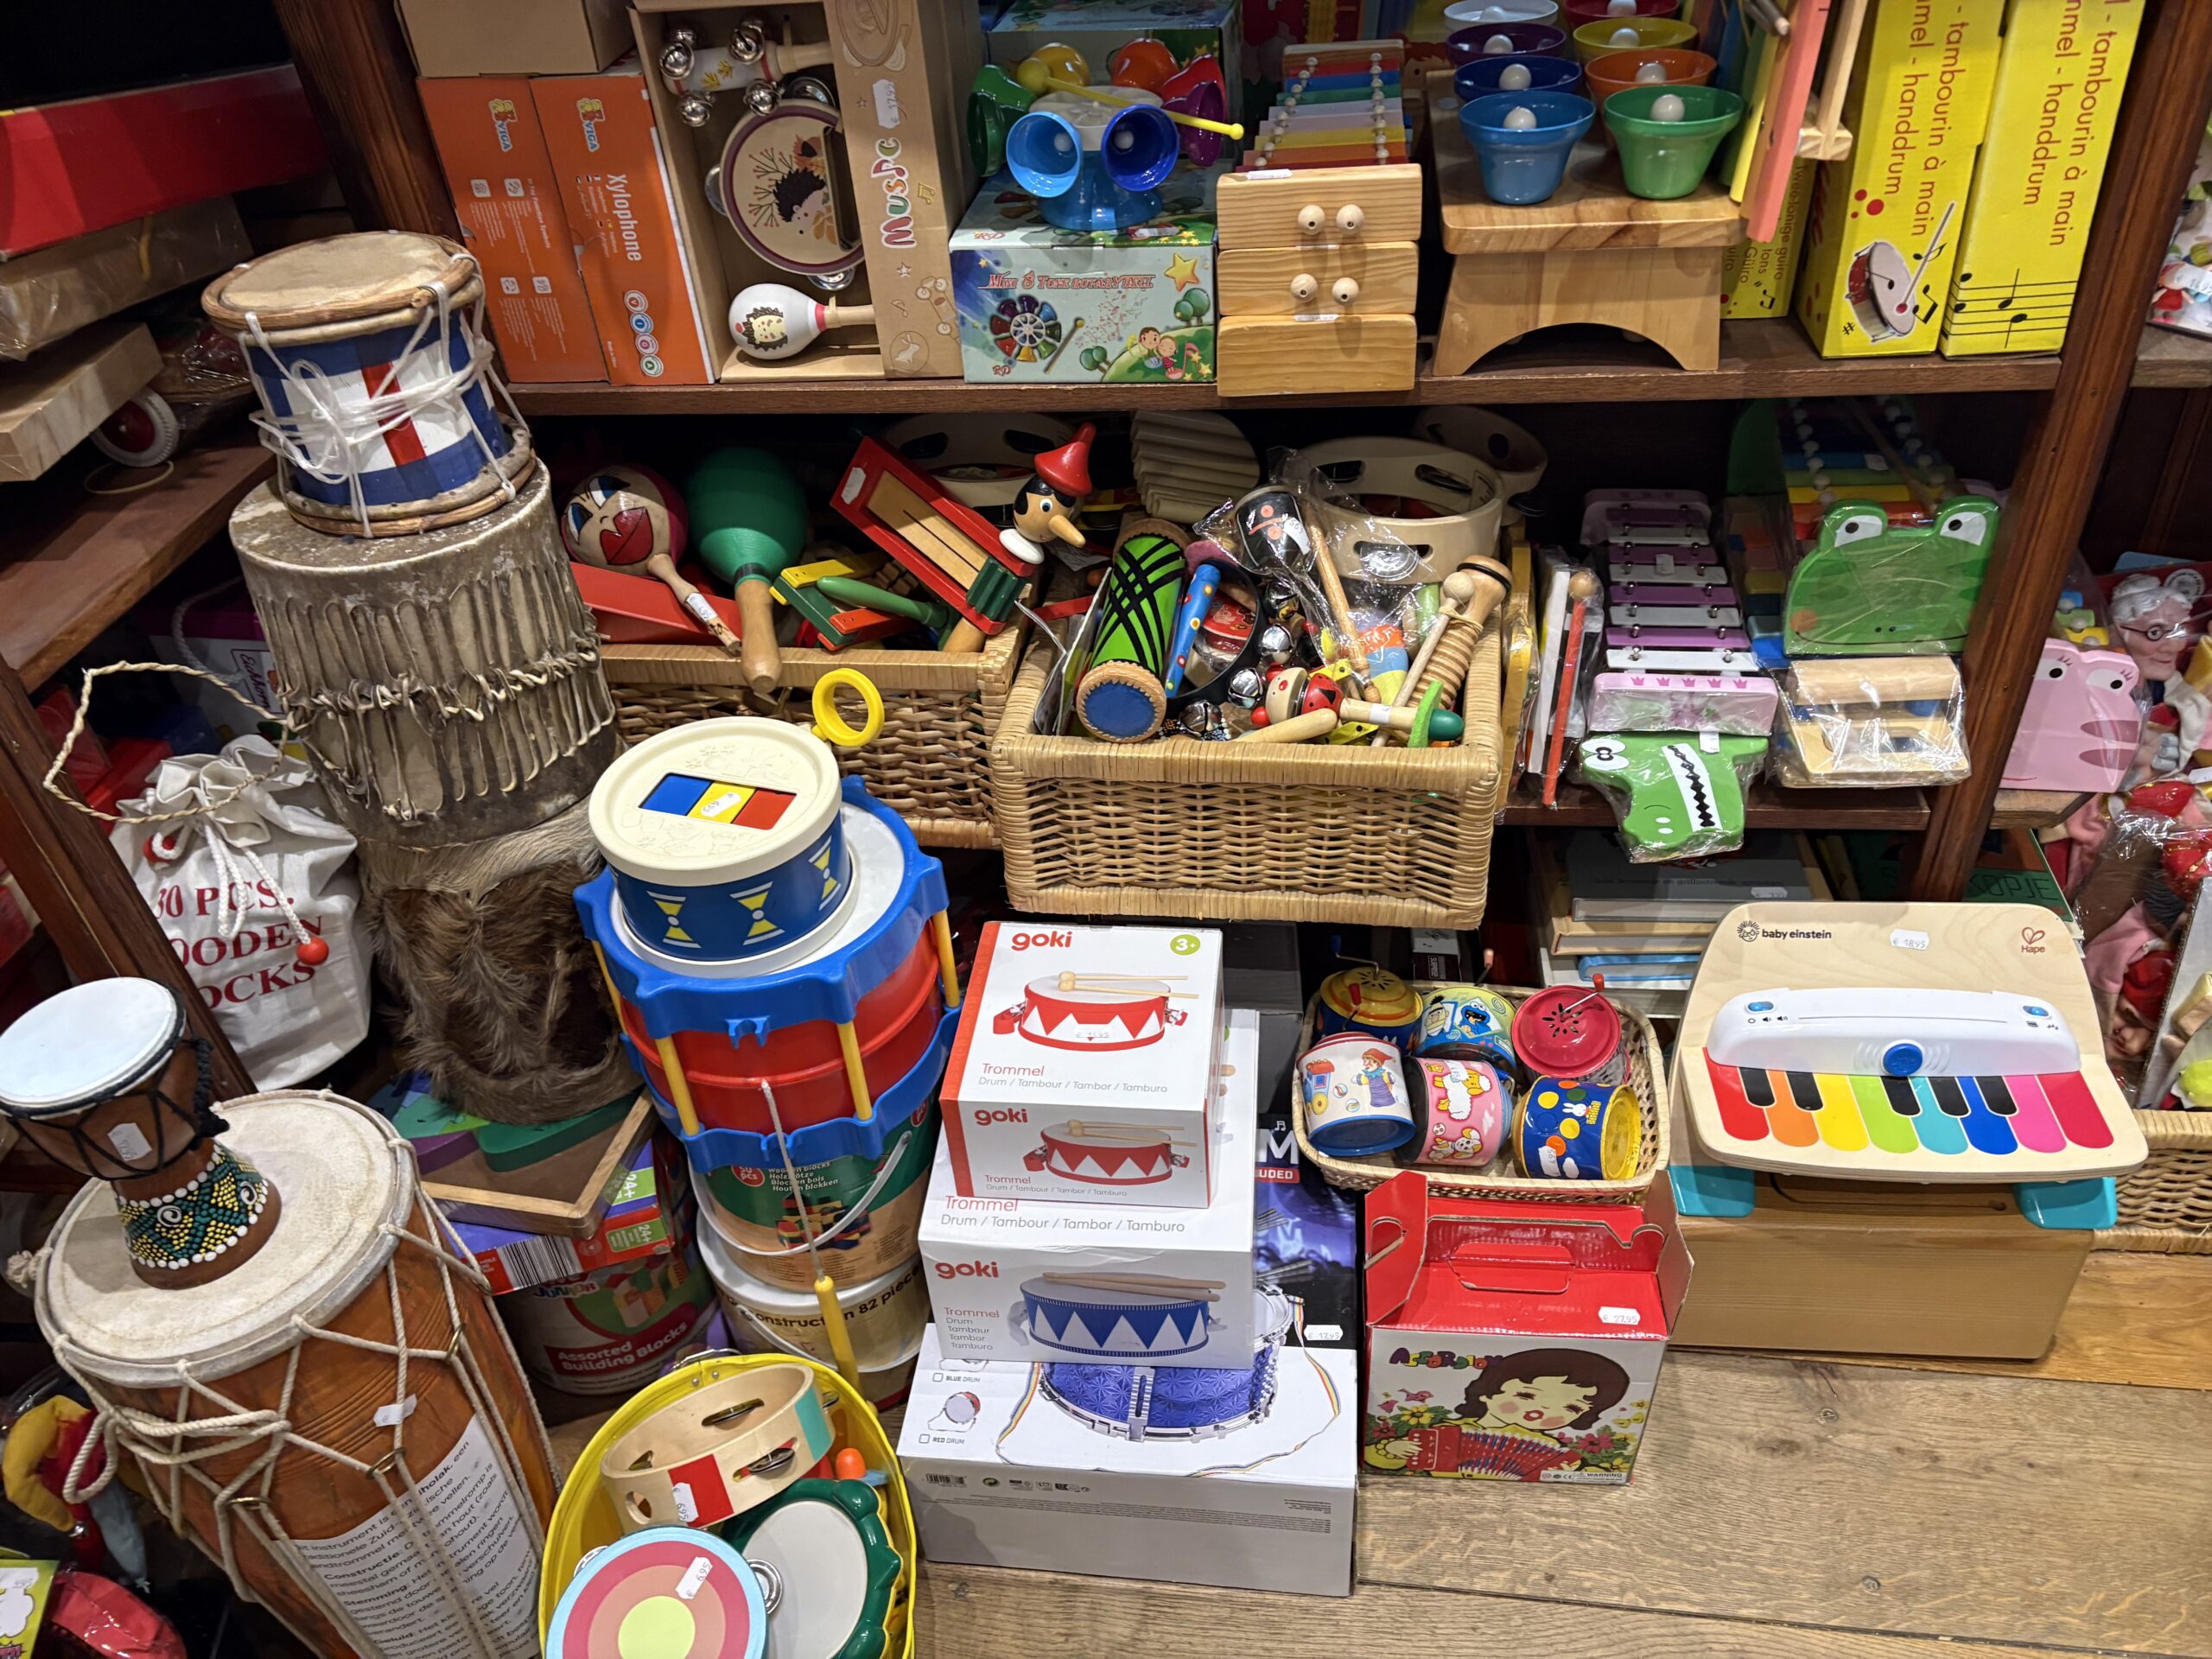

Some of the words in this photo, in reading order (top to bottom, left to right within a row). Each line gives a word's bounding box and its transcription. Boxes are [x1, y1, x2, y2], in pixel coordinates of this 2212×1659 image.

[1928, 21, 1969, 147] tambourin
[2069, 31, 2118, 156] tambourin
[497, 121, 512, 151] VIGA
[584, 121, 599, 151] VIGA
[1885, 73, 1929, 195] handdrum
[2023, 82, 2075, 206] handdrum
[1923, 156, 1947, 171] à
[2063, 166, 2088, 181] à
[606, 174, 642, 262] Xylophone
[1911, 181, 1936, 237] main
[2049, 191, 2075, 246] main
[195, 879, 295, 918] PCS.
[168, 915, 323, 968] OODEN
[1011, 931, 1072, 951] goki
[1762, 929, 1789, 941] baby
[1789, 930, 1832, 939] einstein
[1174, 938, 1197, 951] 3+
[2021, 944, 2046, 954] Hape
[197, 961, 315, 1010] OCKS
[982, 1063, 1045, 1077] Trommel
[978, 1077, 1007, 1086] Drum
[1018, 1078, 1062, 1089] Tambour
[1073, 1080, 1111, 1090] Tambor
[1122, 1082, 1168, 1093] Tamburo
[974, 1108, 1028, 1126] goki
[621, 1173, 638, 1199] 24+
[772, 1184, 804, 1192] Houtn
[804, 1179, 839, 1192] blokken
[807, 1175, 824, 1184] bois
[984, 1175, 1032, 1185] Trommel
[1015, 1185, 1049, 1193] Tambour
[1093, 1188, 1128, 1197] Tamburo
[945, 1196, 1019, 1211] Trommel
[941, 1214, 977, 1226] Drum
[991, 1215, 1049, 1229] Tambour
[1063, 1217, 1113, 1230] Tambor
[1126, 1219, 1185, 1232] Tamburo
[638, 1224, 651, 1244] 24+
[935, 1261, 999, 1280] goki
[858, 1300, 878, 1315] 82
[944, 1307, 1000, 1319] Trommel
[946, 1317, 974, 1325] Drum
[948, 1325, 990, 1334] Tambour
[563, 1354, 635, 1371] Building
[635, 1321, 688, 1358] Blocks
[950, 1333, 986, 1342] Tambor
[951, 1342, 994, 1351] Tamburo
[558, 1341, 632, 1362] Assorted
[453, 1503, 475, 1529] hout
[312, 1523, 378, 1552] instrument
